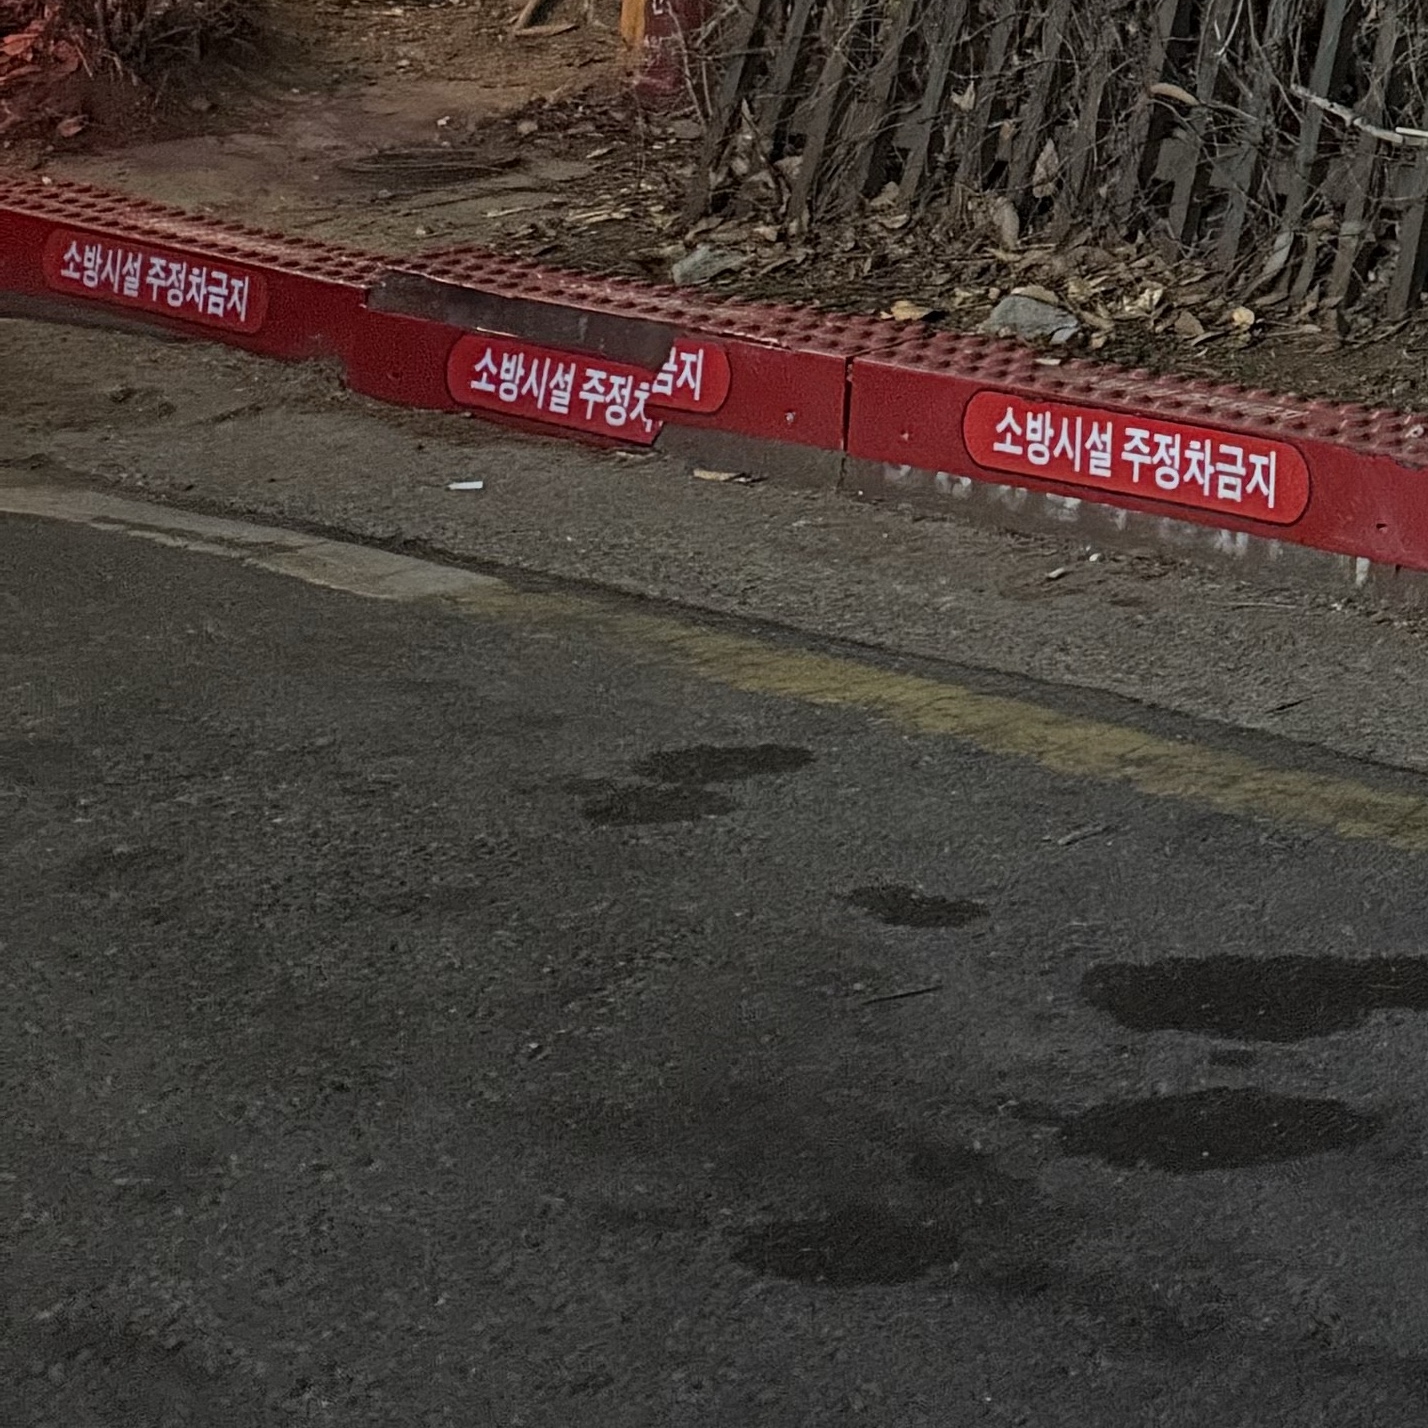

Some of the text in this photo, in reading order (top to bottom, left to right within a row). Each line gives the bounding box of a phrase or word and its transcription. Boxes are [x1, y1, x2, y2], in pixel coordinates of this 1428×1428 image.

[61, 240, 249, 322] 소방시설 주정차금지
[470, 348, 576, 414] 소방시설
[993, 406, 1277, 509] 소방시설 주정차금지
